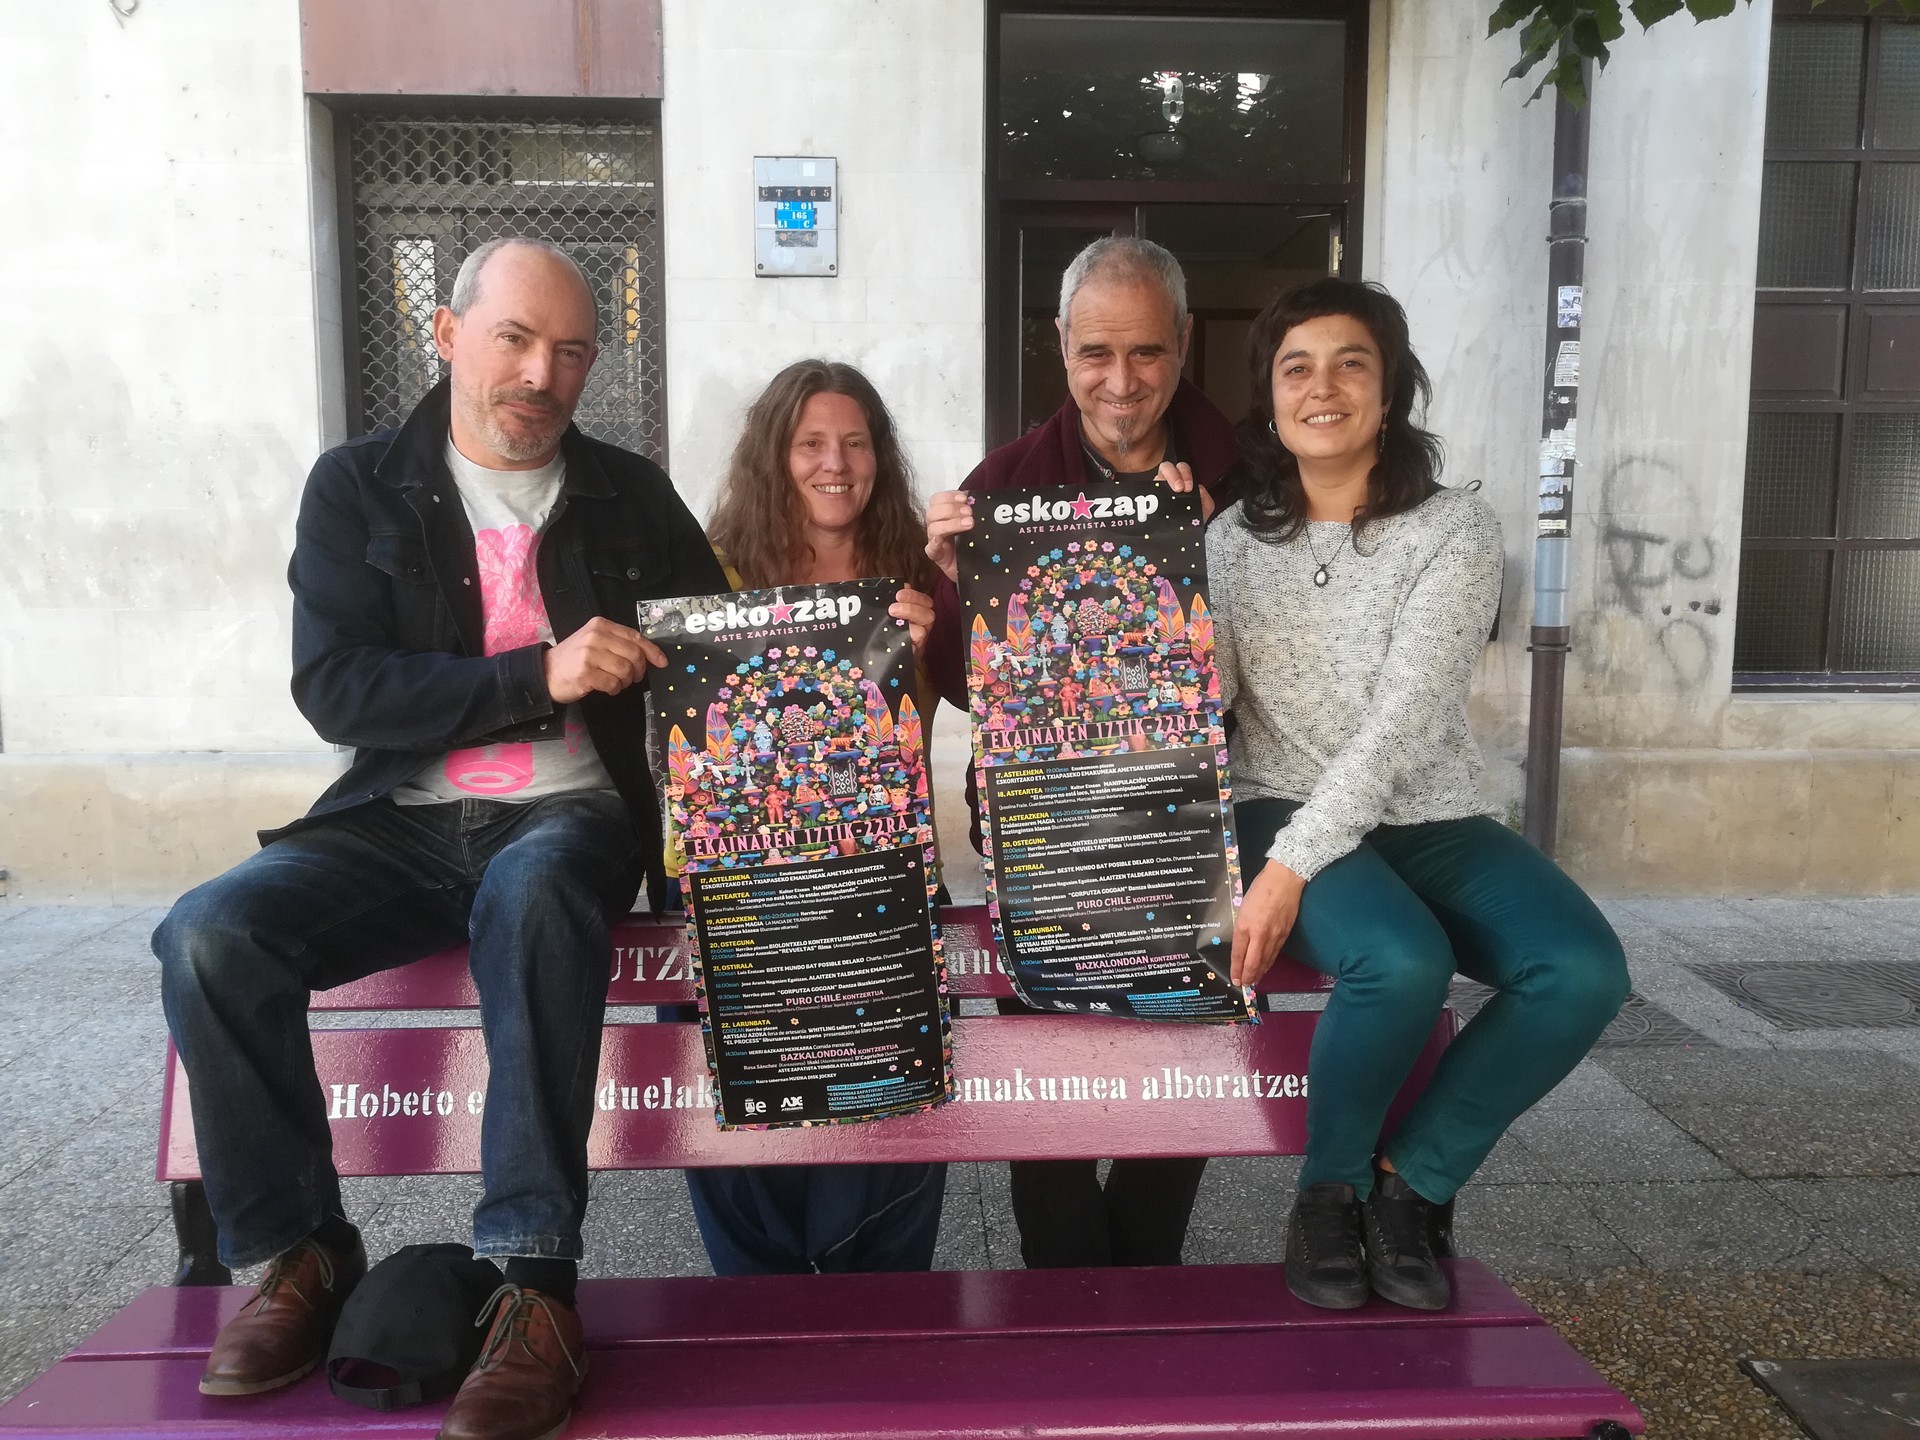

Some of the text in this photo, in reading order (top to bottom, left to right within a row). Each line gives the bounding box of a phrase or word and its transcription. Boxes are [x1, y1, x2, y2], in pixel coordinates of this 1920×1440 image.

[1093, 493, 1158, 522] zap
[1019, 519, 1135, 534] ASTE ZAPATISTA 2019
[792, 594, 862, 627] zap
[714, 622, 838, 643] ASTE ZAPATISTA 2019
[991, 725, 1087, 748] EKAINAREN
[694, 829, 795, 854] EKAINAREN
[610, 947, 695, 982] TZ
[328, 1083, 451, 1120] Hobeto
